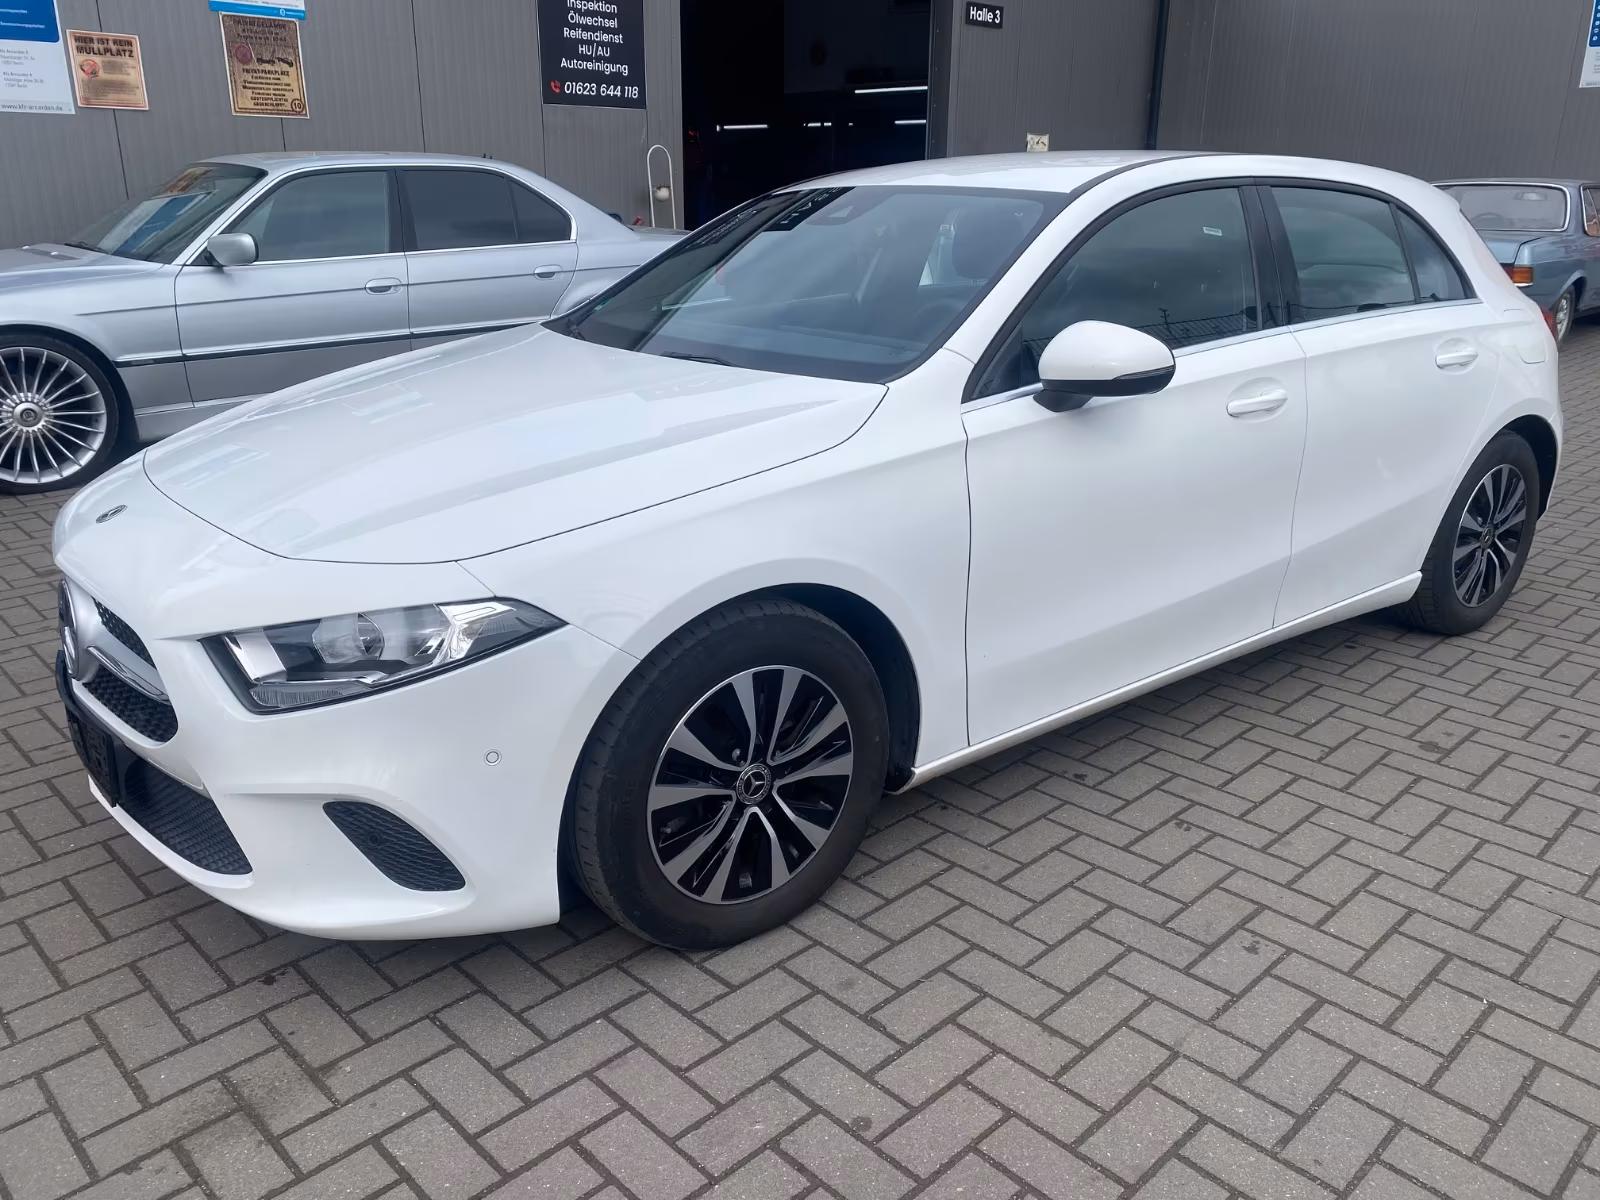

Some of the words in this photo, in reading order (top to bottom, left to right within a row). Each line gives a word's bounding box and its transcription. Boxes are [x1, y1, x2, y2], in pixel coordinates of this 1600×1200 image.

[567, 0, 617, 13] Inspektion
[568, 10, 618, 28] Ölwechsel
[970, 6, 994, 22] Halle
[994, 9, 1001, 24] 3
[74, 36, 95, 44] HIER
[97, 37, 109, 46] IST
[112, 39, 133, 48] KEIN
[563, 27, 623, 43] Reifendienst
[578, 43, 610, 57] HU/AU
[560, 57, 628, 76] Autoreinigung
[564, 81, 597, 95] 01623
[600, 84, 621, 97] 644
[624, 86, 639, 98] 118
[293, 102, 302, 110] 10
